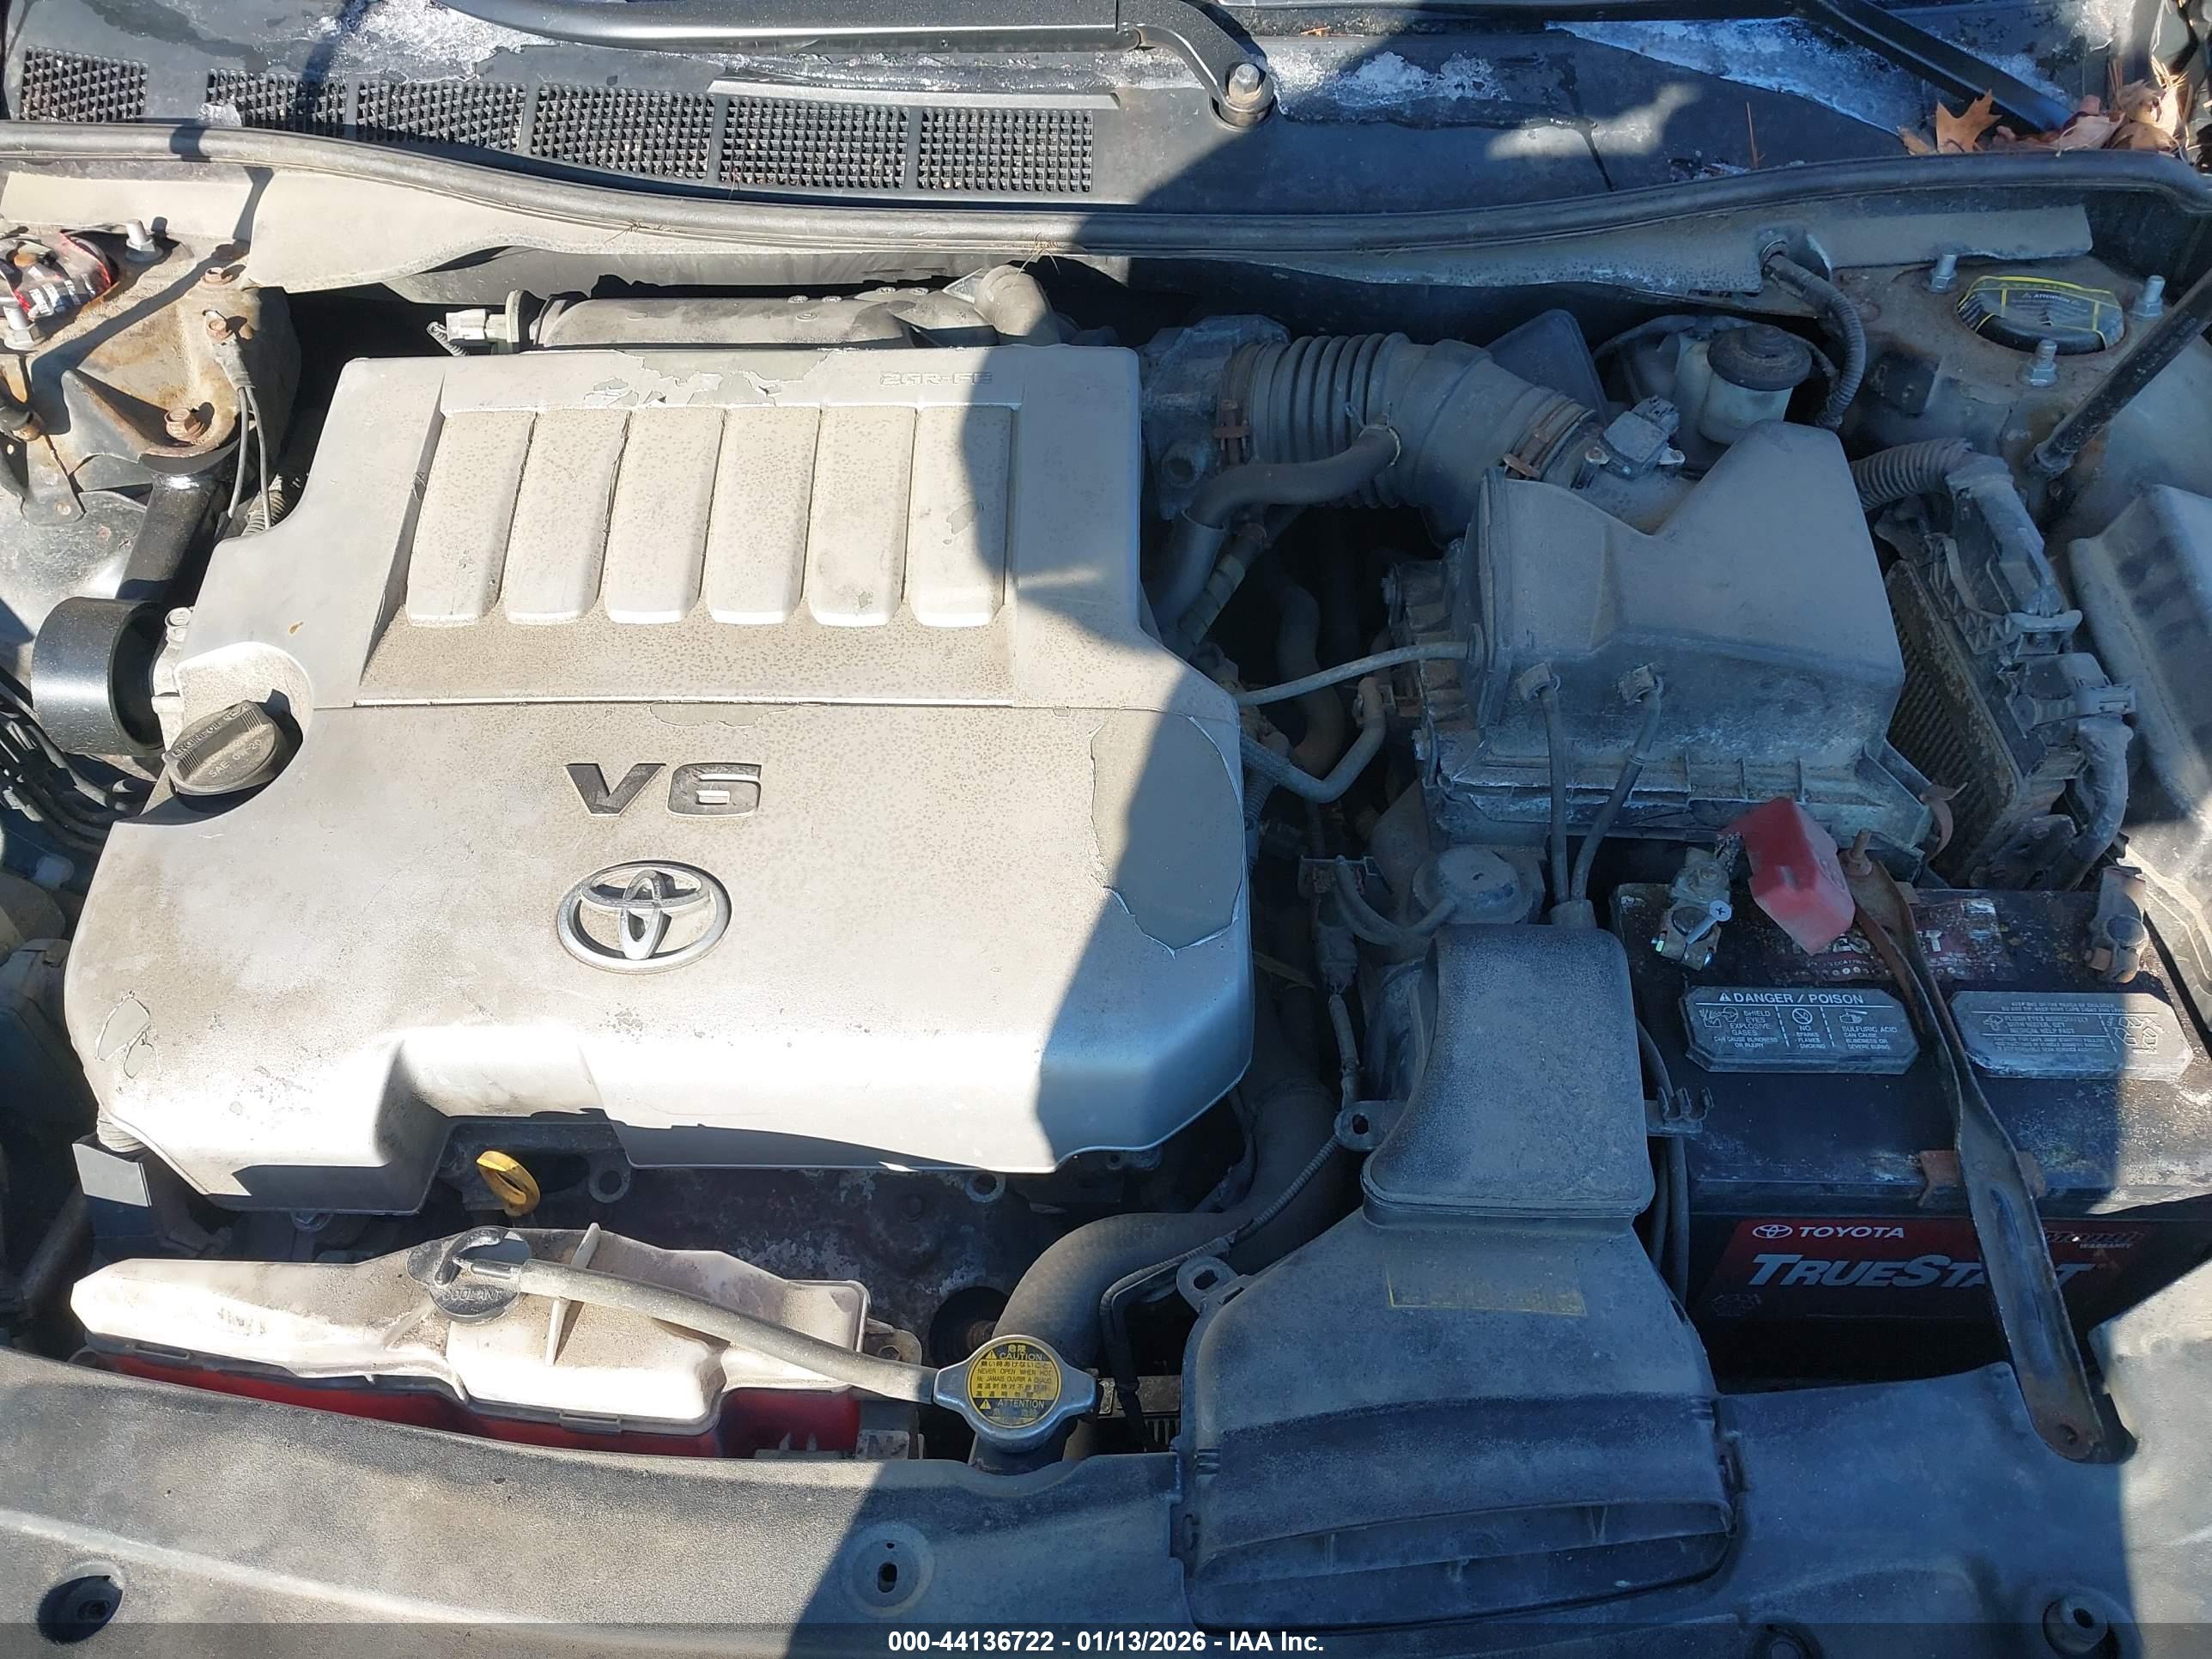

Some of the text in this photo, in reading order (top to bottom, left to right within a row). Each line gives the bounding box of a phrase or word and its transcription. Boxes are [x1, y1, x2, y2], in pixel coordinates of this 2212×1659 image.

[208, 761, 231, 778] SAE
[563, 763, 763, 818] V6
[1733, 993, 1864, 1004] DANGER / POISON
[1799, 1226, 1905, 1238] TOYOTA
[1748, 1255, 2095, 1287] TRUESTAT
[999, 1352, 1042, 1360] CAUTION
